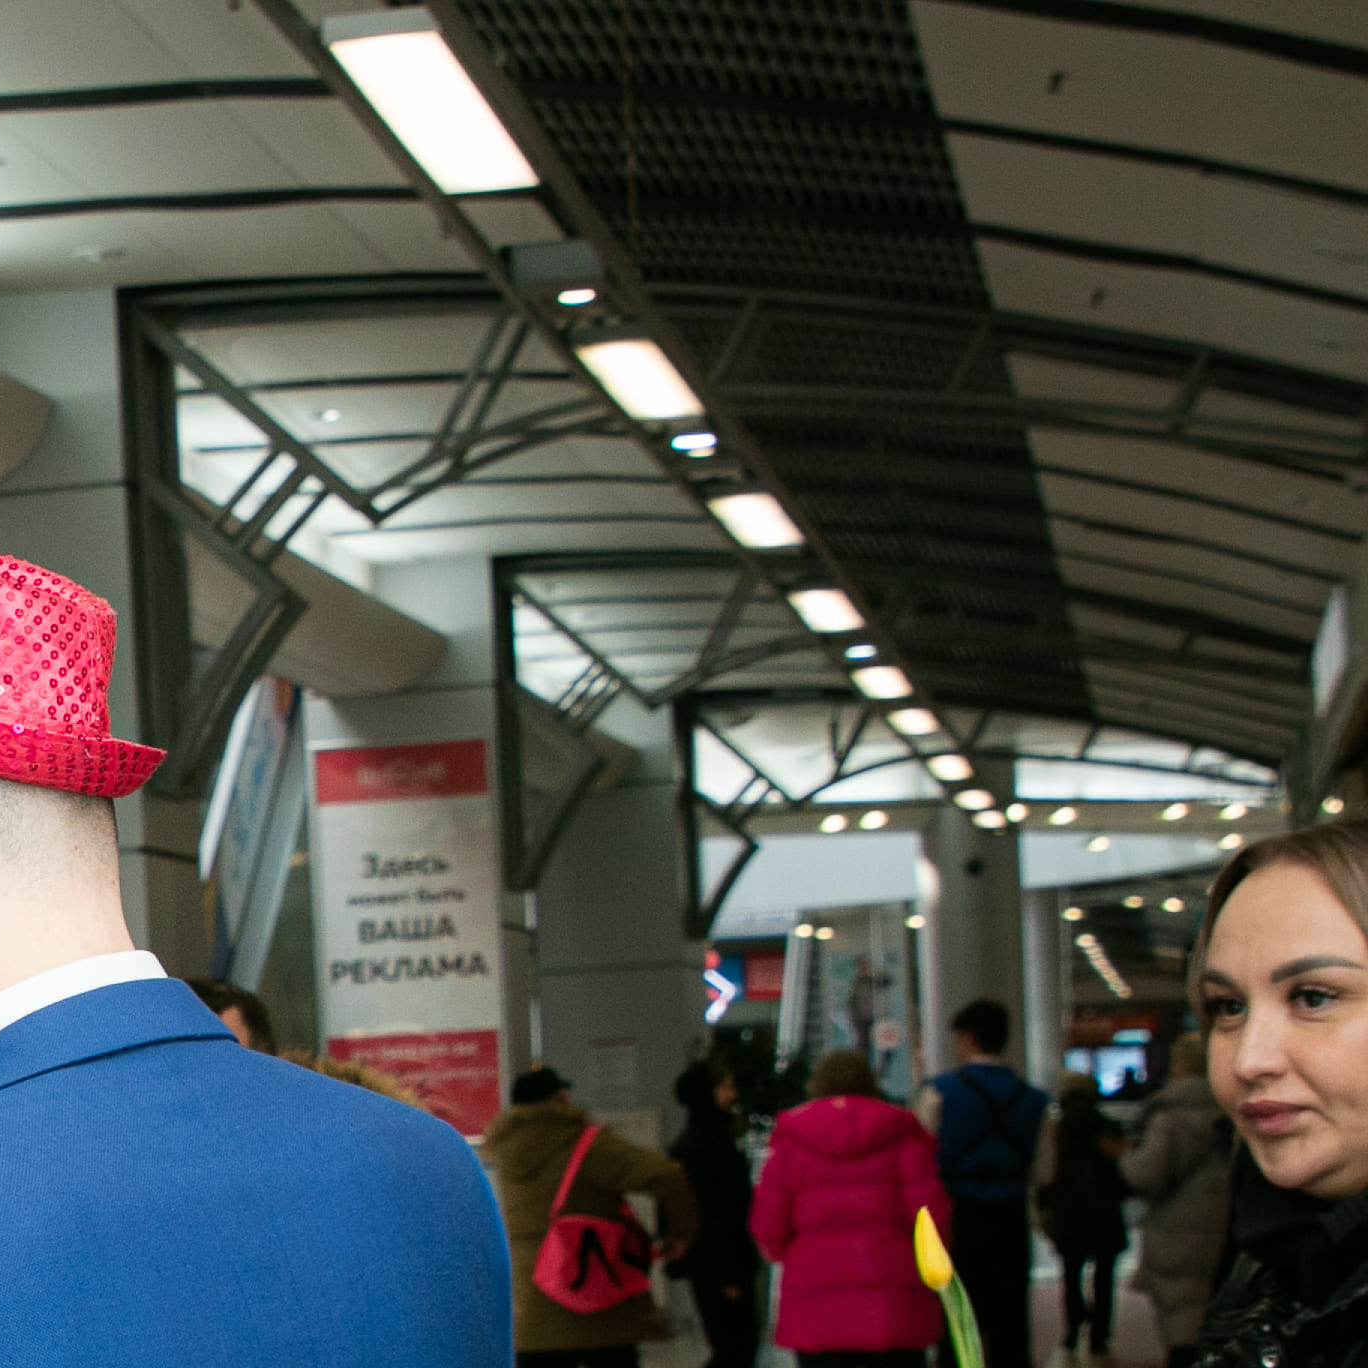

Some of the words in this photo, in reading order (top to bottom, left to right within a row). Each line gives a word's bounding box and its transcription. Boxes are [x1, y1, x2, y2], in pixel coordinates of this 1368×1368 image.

[361, 852, 450, 879] Здесь
[358, 913, 457, 944] ВАША
[330, 952, 490, 985] РЕКЛАМА
